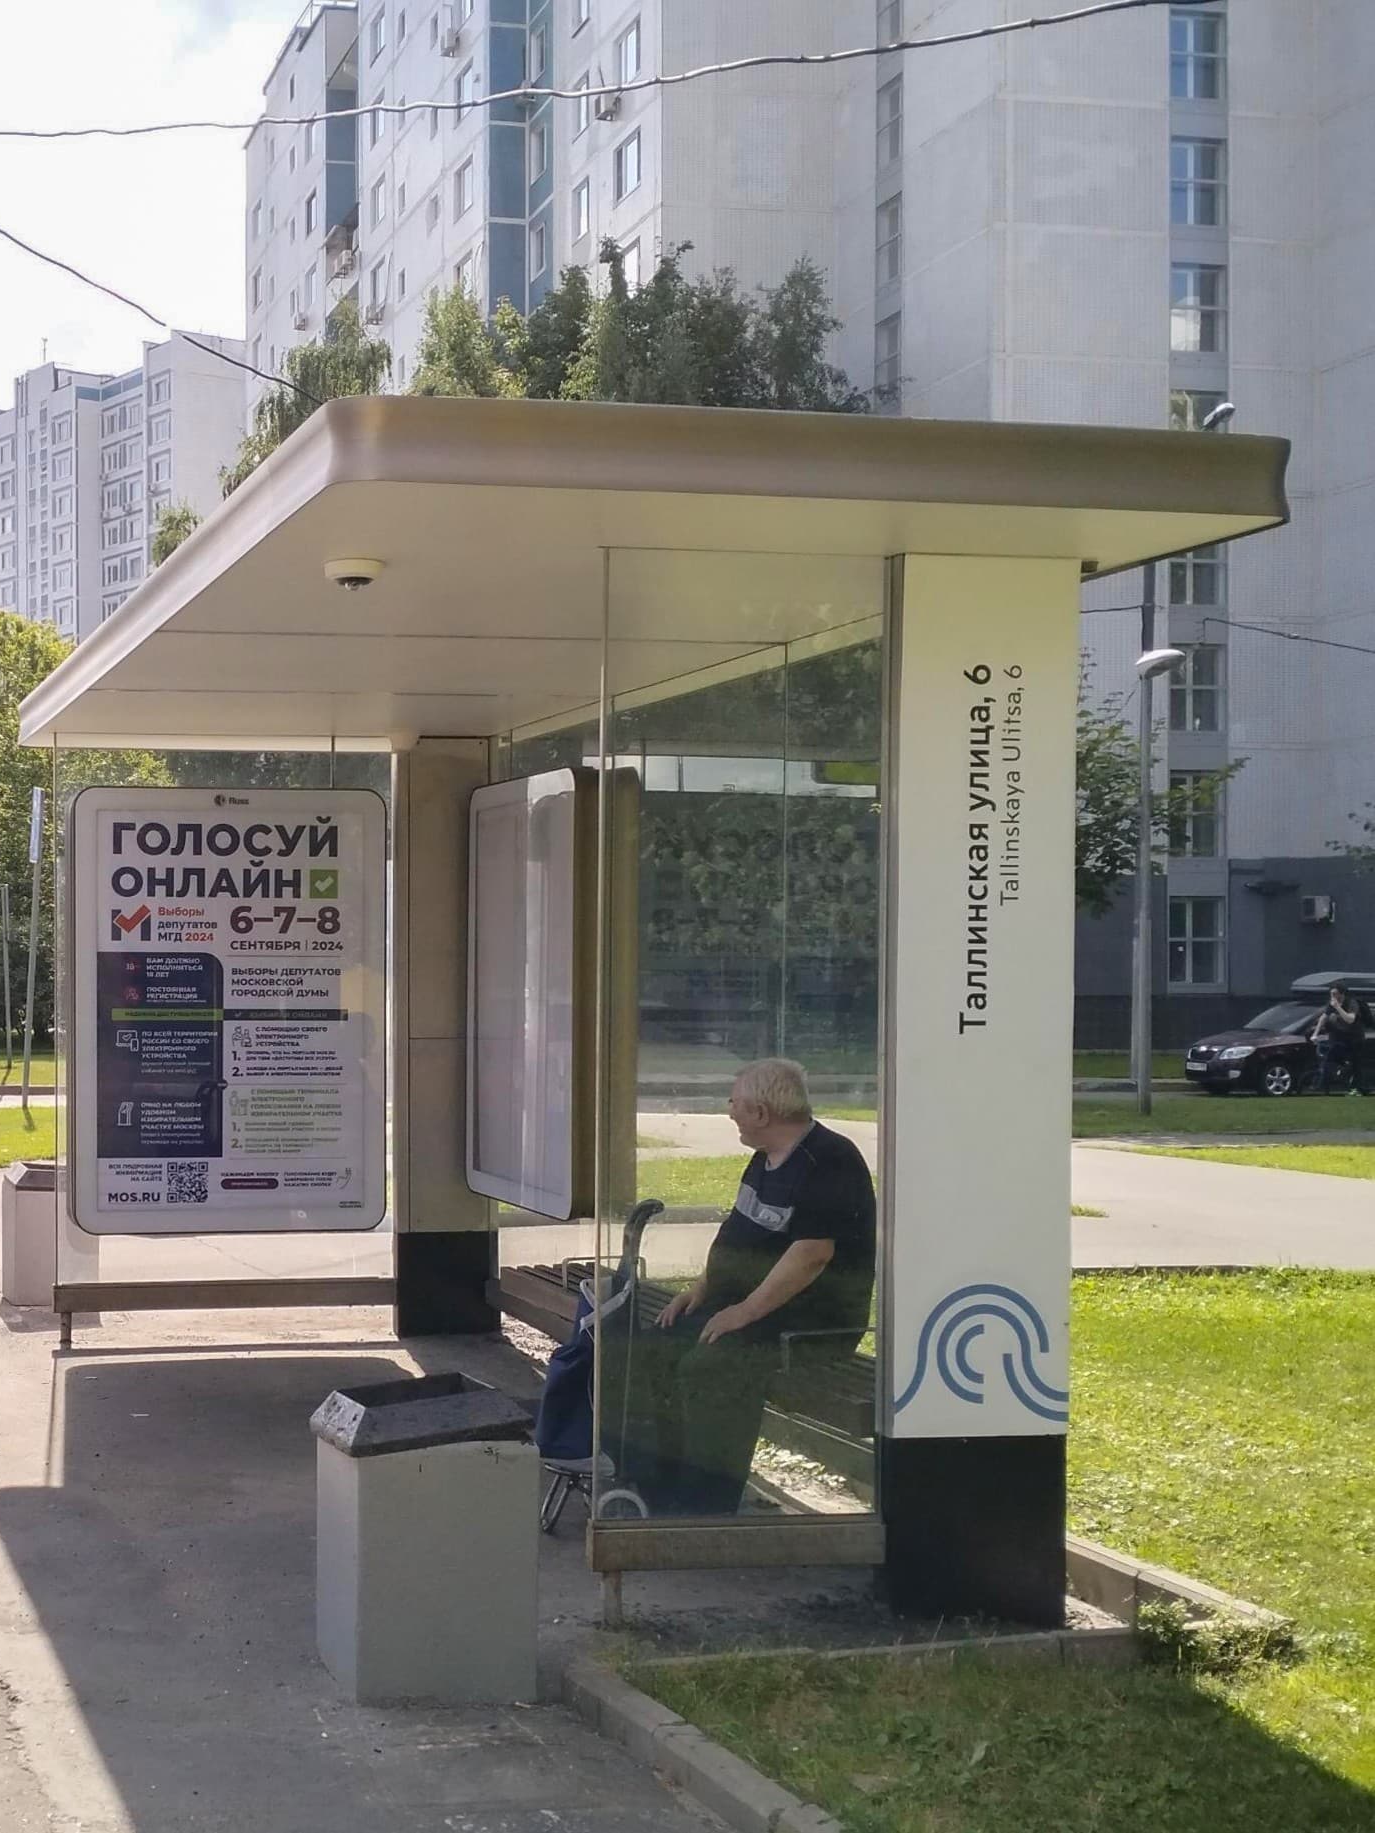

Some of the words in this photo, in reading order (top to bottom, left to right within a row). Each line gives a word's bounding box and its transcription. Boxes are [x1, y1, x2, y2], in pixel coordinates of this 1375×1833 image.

[963, 663, 992, 685] 6
[1003, 664, 1023, 679] 6
[1000, 686, 1025, 762] Ulitsa,
[968, 696, 997, 813] улица,
[112, 815, 339, 858] ГОЛОСУЙ
[999, 769, 1025, 906] Tallinskaya
[111, 859, 302, 899] ОНЛАЙН
[157, 906, 205, 918] Выборы
[157, 919, 218, 931] депутатов
[958, 822, 990, 1035] Таллинская
[157, 932, 183, 943] МГД
[185, 932, 215, 942] 2024
[229, 940, 302, 951] СЕНТЯБРЯ
[311, 941, 344, 952] 2024
[231, 967, 278, 977] ВЫБОРЫ
[280, 968, 342, 978] ДЕПУТАТОВ
[231, 976, 304, 987] МОСКОВСКОЙ
[231, 987, 295, 998] ГОРОДСКОЙ
[296, 988, 329, 999] ДУМЫ
[231, 1066, 244, 1077] 2.
[108, 1192, 161, 1203] MOS.RU
